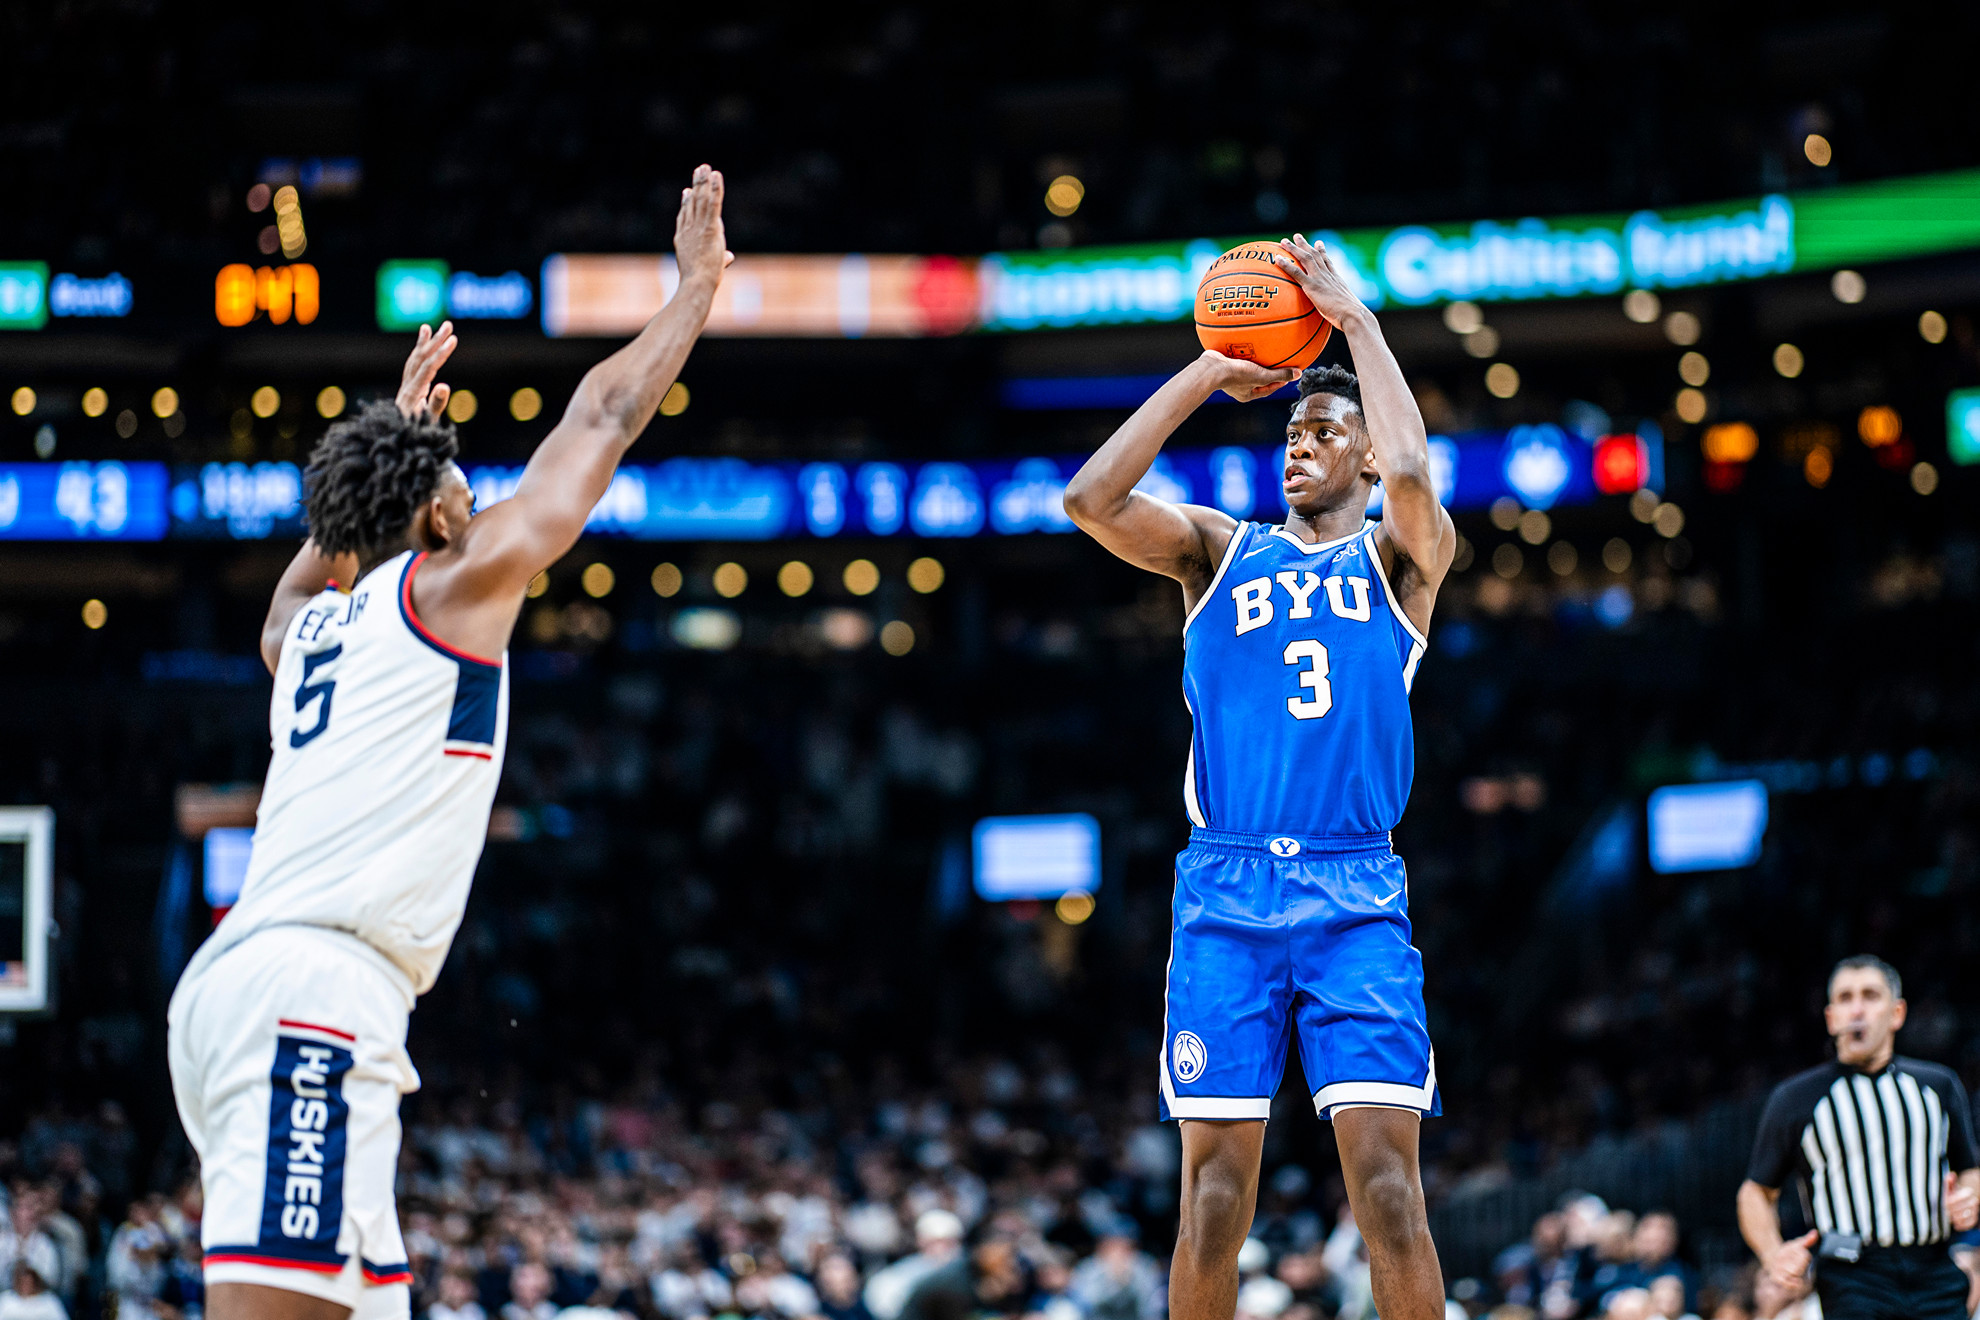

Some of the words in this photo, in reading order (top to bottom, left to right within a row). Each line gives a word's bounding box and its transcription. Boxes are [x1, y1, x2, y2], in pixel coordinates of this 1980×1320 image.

[1207, 250, 1295, 275] PALDIN
[1204, 285, 1279, 302] LEGACY
[1221, 301, 1270, 309] 1000
[337, 591, 369, 626] JR
[1231, 570, 1371, 637] BYU
[290, 642, 343, 748] 5
[1282, 638, 1333, 720] 3
[1275, 840, 1295, 855] Y
[280, 1045, 334, 1240] HUSKIES
